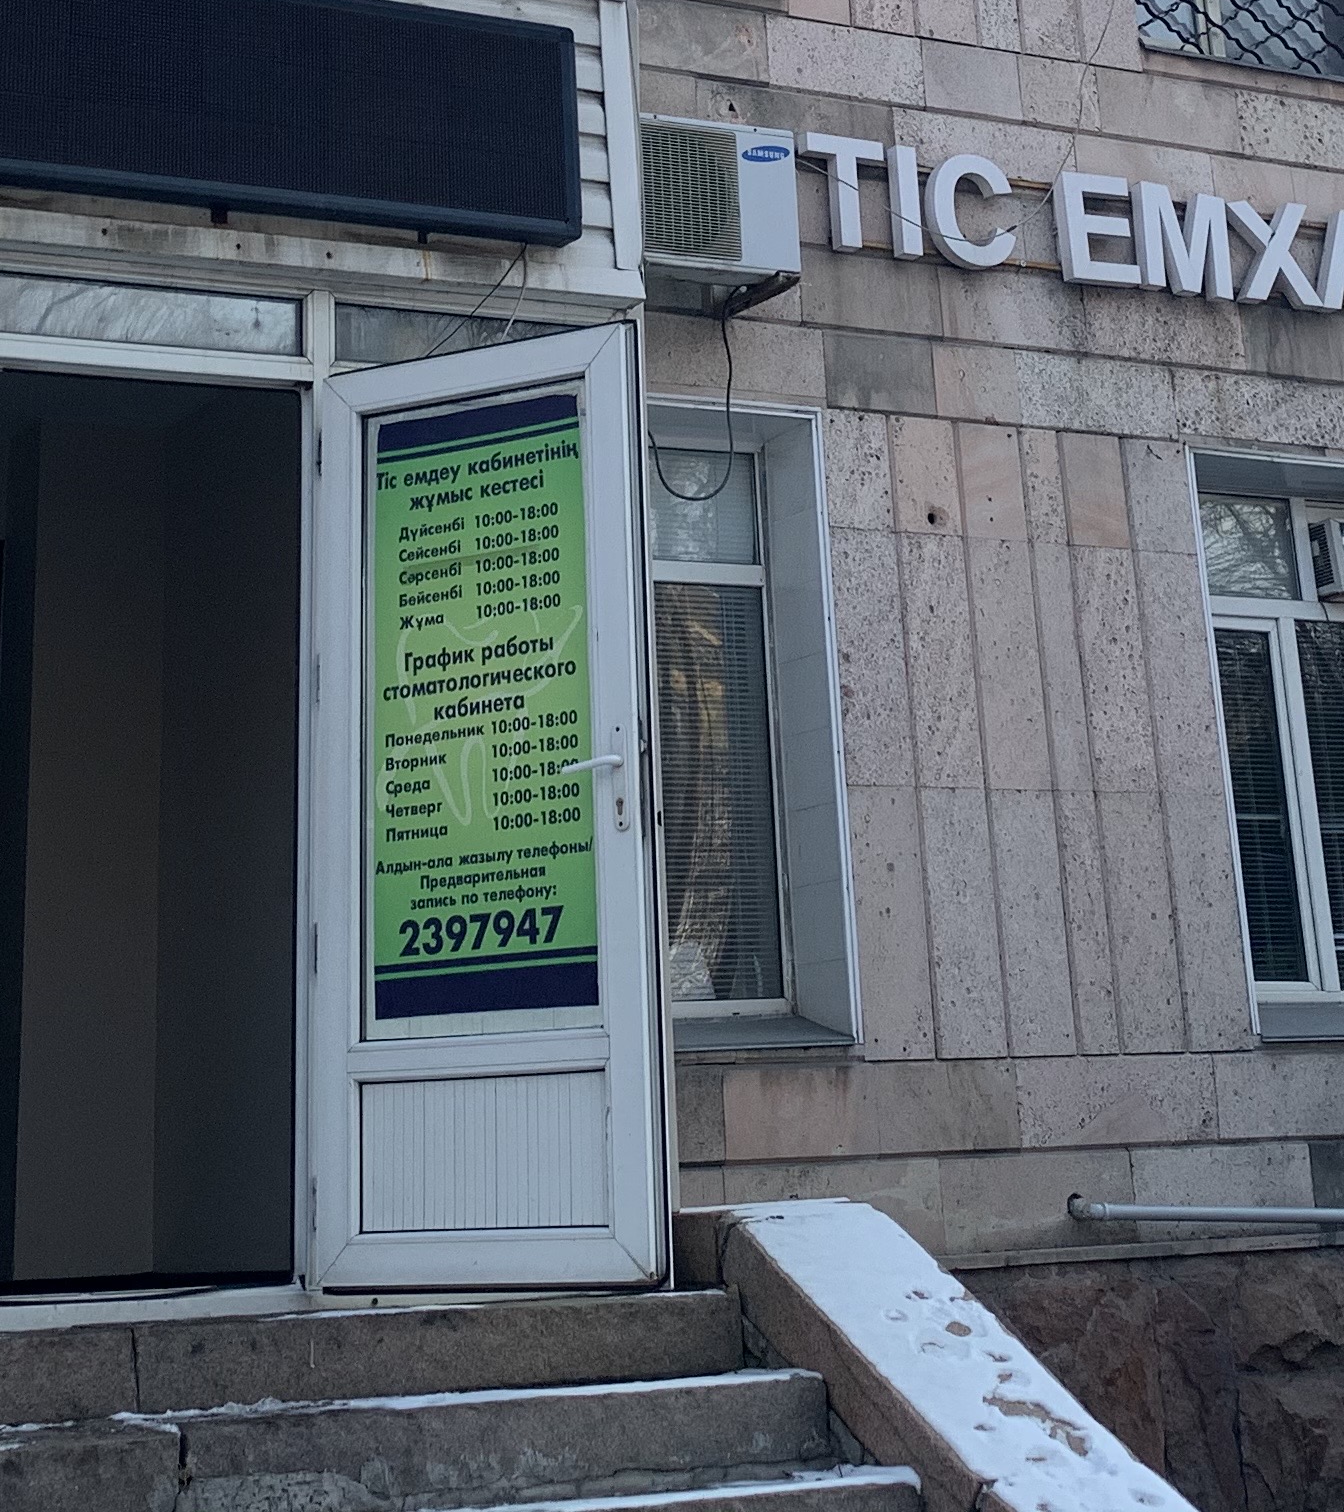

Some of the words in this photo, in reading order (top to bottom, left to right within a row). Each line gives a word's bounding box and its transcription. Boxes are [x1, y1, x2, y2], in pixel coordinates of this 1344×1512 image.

[376, 471, 397, 490] Тіс
[404, 464, 461, 487] емдеу
[468, 440, 579, 475] кабинетінің
[409, 486, 473, 512] жұмыс
[480, 469, 544, 498] кестесі
[399, 517, 465, 543] Дүйсенбі
[475, 502, 559, 529] 10:00-18:00
[399, 540, 462, 563] Сейсенбі
[475, 524, 559, 551] 10:00-18:00
[475, 547, 560, 573] 10:00-18:00
[399, 585, 463, 608] Бейсенбі
[476, 570, 561, 596] 10:00-18:00
[476, 593, 561, 620] 10:00-18:00
[404, 646, 475, 675] График
[481, 635, 554, 663] работы
[383, 660, 577, 702] стоматологического
[434, 694, 525, 721] кабинета
[385, 723, 485, 749] Понедельник
[491, 710, 578, 735] 10:00-18:00
[385, 752, 447, 773] Вторник
[492, 734, 579, 759] 10:00-18:00
[385, 779, 431, 797] Среда
[385, 801, 444, 819] Четверг
[492, 782, 580, 807] 10:00-18:00
[385, 824, 449, 843] Пятница
[493, 807, 581, 831] 10:00-18:00
[375, 855, 453, 877] Алдын-ала
[458, 849, 513, 866] жазылу
[419, 865, 546, 892] Предварительная
[410, 896, 457, 911] запись
[460, 893, 479, 906] по
[482, 884, 558, 903] телефону:
[398, 904, 565, 959] 2397947
